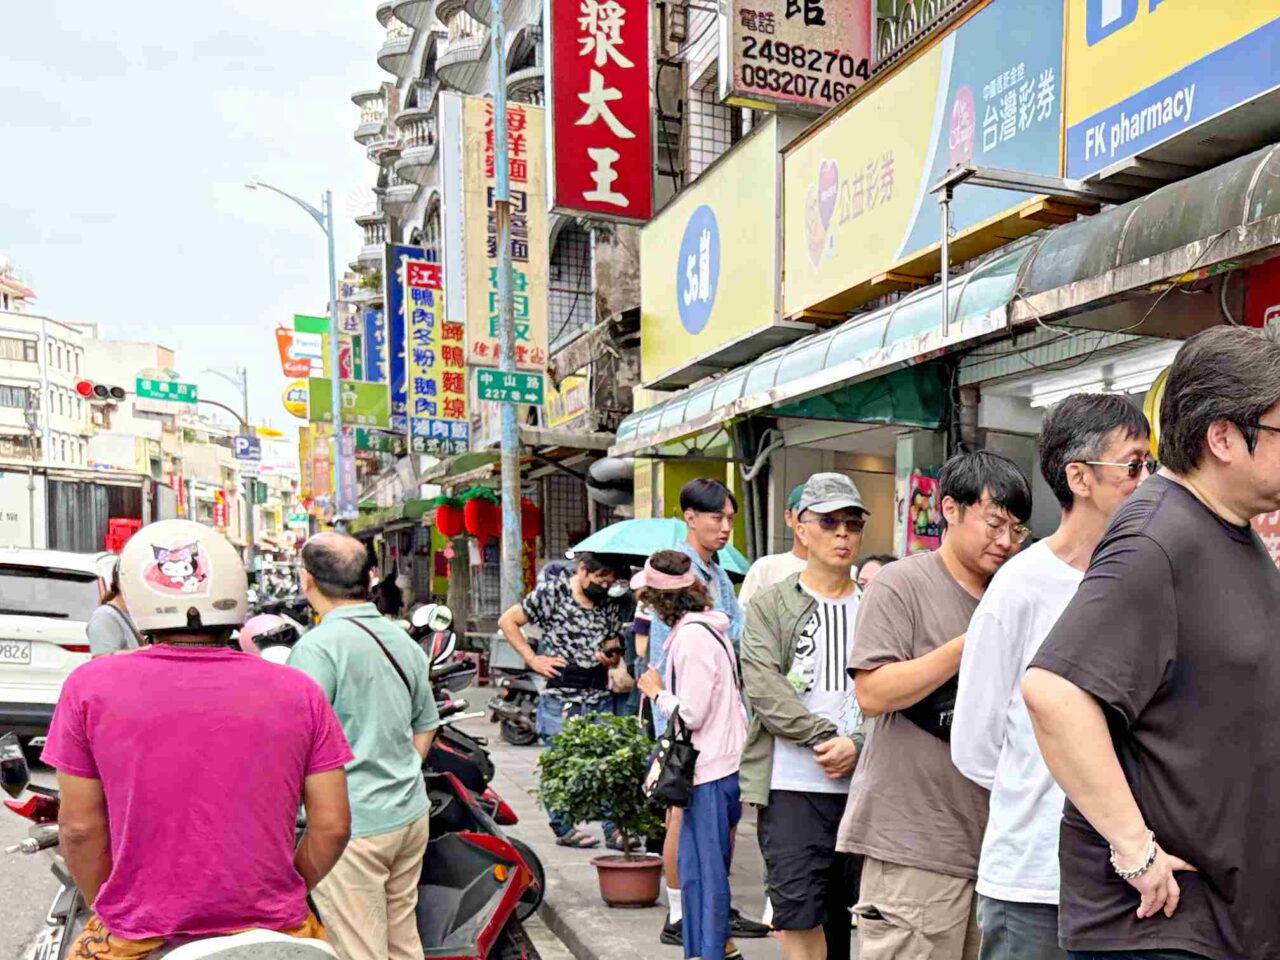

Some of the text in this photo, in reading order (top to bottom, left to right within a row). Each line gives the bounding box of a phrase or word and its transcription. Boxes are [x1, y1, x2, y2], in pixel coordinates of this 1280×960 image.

[740, 9, 775, 35] 電話
[741, 36, 871, 81] 24982704
[982, 66, 1056, 153] 台灣彩券
[1085, 83, 1195, 161] FK pharmacy
[838, 151, 895, 225] 公益彩券
[480, 372, 540, 389] 中山路
